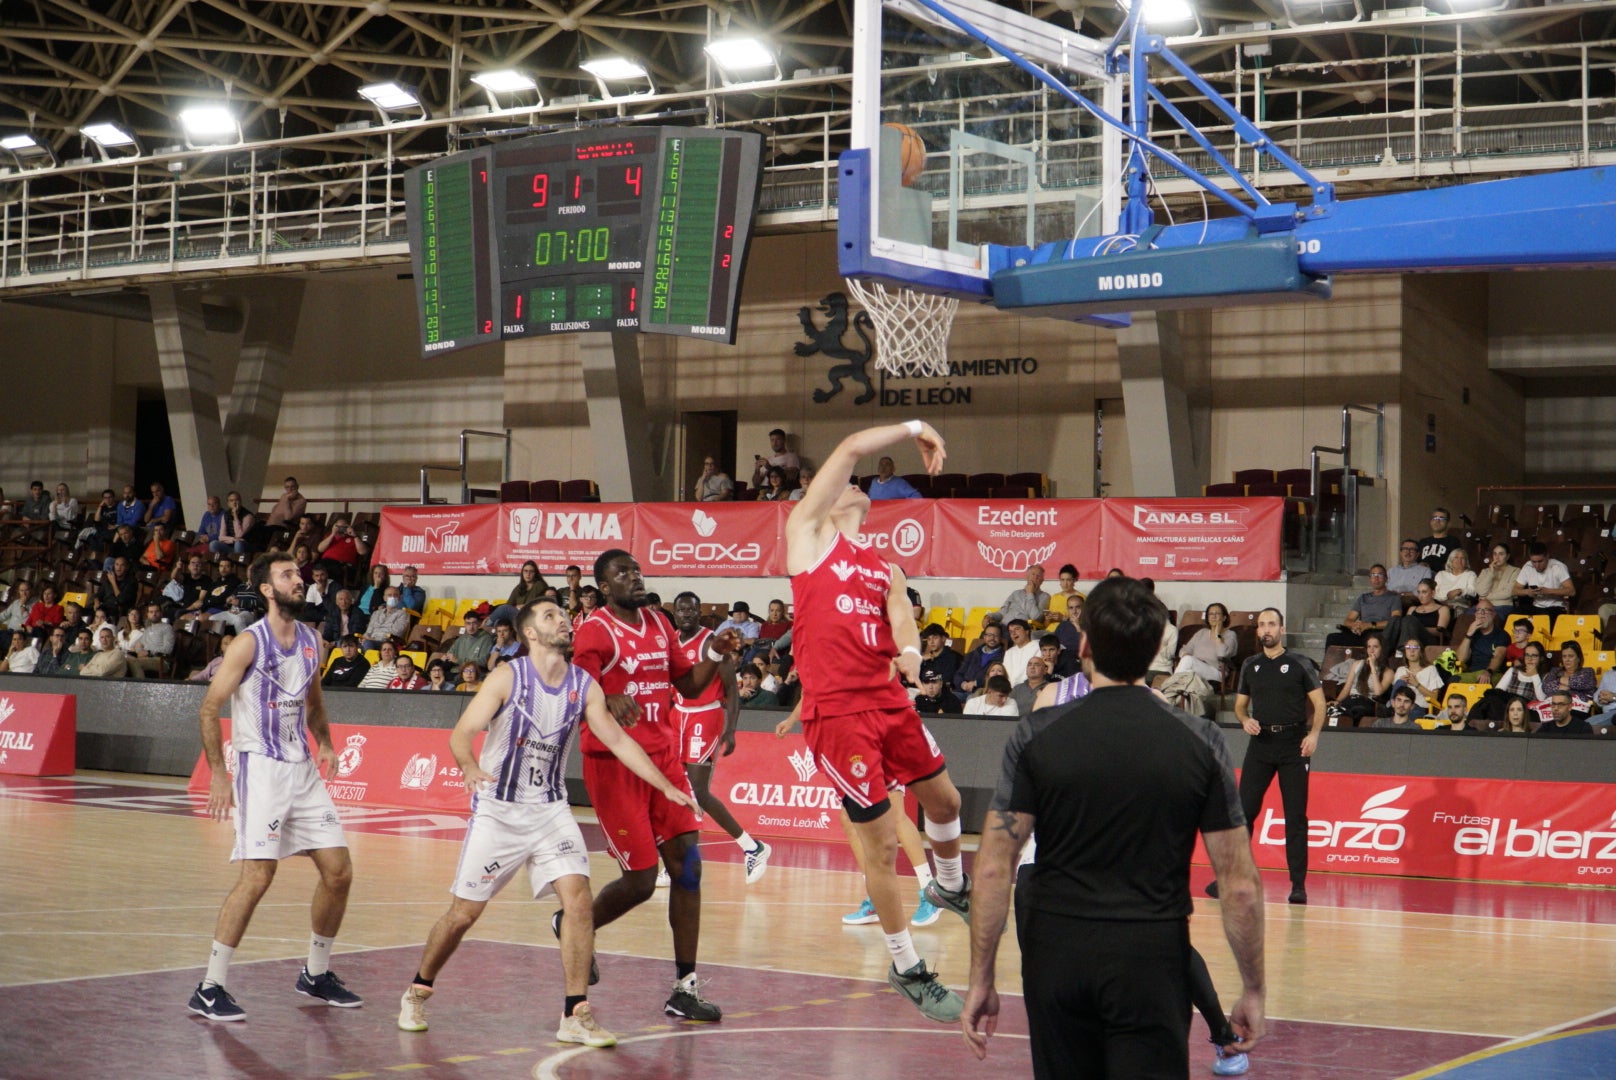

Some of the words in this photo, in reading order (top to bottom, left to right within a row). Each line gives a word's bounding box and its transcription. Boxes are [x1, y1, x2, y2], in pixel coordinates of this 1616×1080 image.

[673, 139, 681, 151] E
[672, 153, 680, 165] 5
[427, 170, 434, 182] E
[670, 167, 678, 180] 6
[574, 175, 581, 199] 1
[625, 166, 642, 196] 4
[532, 174, 548, 208] 9
[428, 196, 434, 208] 5
[661, 196, 677, 209] 11
[427, 209, 435, 222] 6
[558, 205, 586, 215] PERIODO
[660, 210, 675, 223] 13
[659, 224, 674, 237] 14
[724, 225, 734, 239] 2
[428, 235, 436, 248] 8
[536, 227, 610, 266] 07:00
[657, 239, 672, 252] 15
[608, 261, 642, 270] MONDO
[656, 253, 670, 266] 16
[721, 254, 731, 268] 2
[655, 267, 669, 280] 22
[425, 276, 437, 288] 11
[654, 282, 668, 294] 24
[1098, 272, 1163, 291] MONDO
[425, 289, 438, 302] 13
[629, 287, 637, 312] 1
[426, 302, 438, 315] 17
[515, 294, 523, 319] 1
[653, 296, 667, 309] 35
[426, 316, 439, 329] 23
[484, 320, 493, 334] 2
[550, 321, 591, 331] EXCLUSIONES
[616, 318, 639, 327] FALTAS
[427, 329, 440, 343] 33
[503, 325, 525, 334] FALTAS
[691, 325, 726, 335] MONDO
[424, 340, 455, 352] MONDO
[885, 388, 912, 406] DE
[916, 382, 972, 406] LEÓN
[977, 504, 1058, 526] Ezedent
[546, 512, 623, 540] IXMA
[401, 521, 469, 553] BUNNHAM
[859, 533, 889, 549] erc
[989, 529, 1010, 538] Smile
[1010, 529, 1045, 540] Designers
[1188, 535, 1222, 543] METÁLICAS
[1222, 535, 1245, 543] CAÑAS
[1421, 543, 1447, 560] GAP
[861, 622, 878, 647] 11
[645, 702, 660, 722] 17
[694, 723, 703, 736] 0
[529, 766, 544, 787] 13
[442, 780, 465, 788] ACAD
[327, 784, 366, 801] ONCESTO
[729, 782, 786, 807] CAJA
[786, 785, 842, 810] RUR
[757, 814, 791, 827] Somos
[792, 816, 818, 828] León
[1432, 811, 1491, 826] Frutas
[1453, 817, 1500, 856] el
[1504, 818, 1616, 860] bierz
[1326, 853, 1360, 862] grupo
[1577, 865, 1614, 875] grupo
